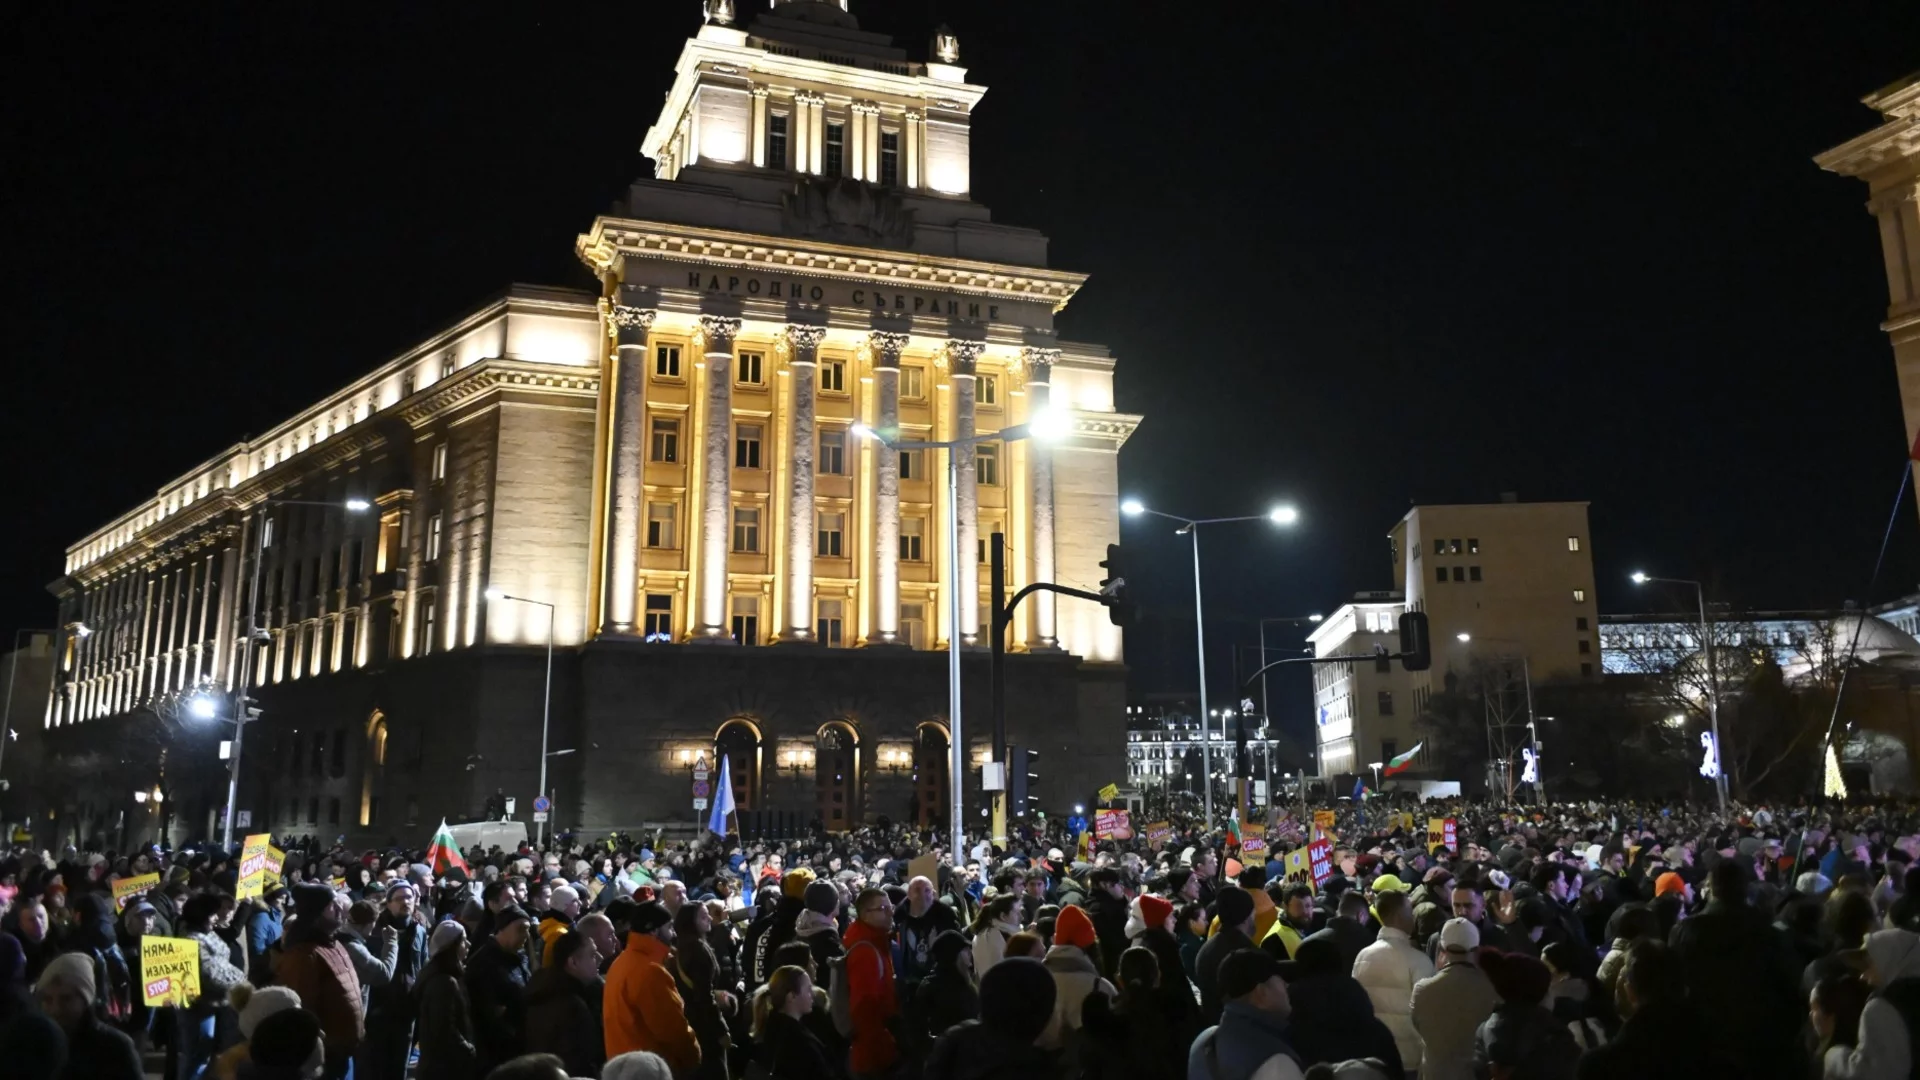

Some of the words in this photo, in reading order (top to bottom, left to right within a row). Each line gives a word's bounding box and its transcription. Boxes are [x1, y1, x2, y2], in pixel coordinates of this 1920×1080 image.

[687, 272, 824, 300] НАРОДНО
[852, 289, 999, 319] СЪБРАНИЕ
[143, 942, 175, 958] НЯМА
[145, 960, 193, 978] ИЗЛЪЖАТ!
[148, 979, 170, 997] STOP
